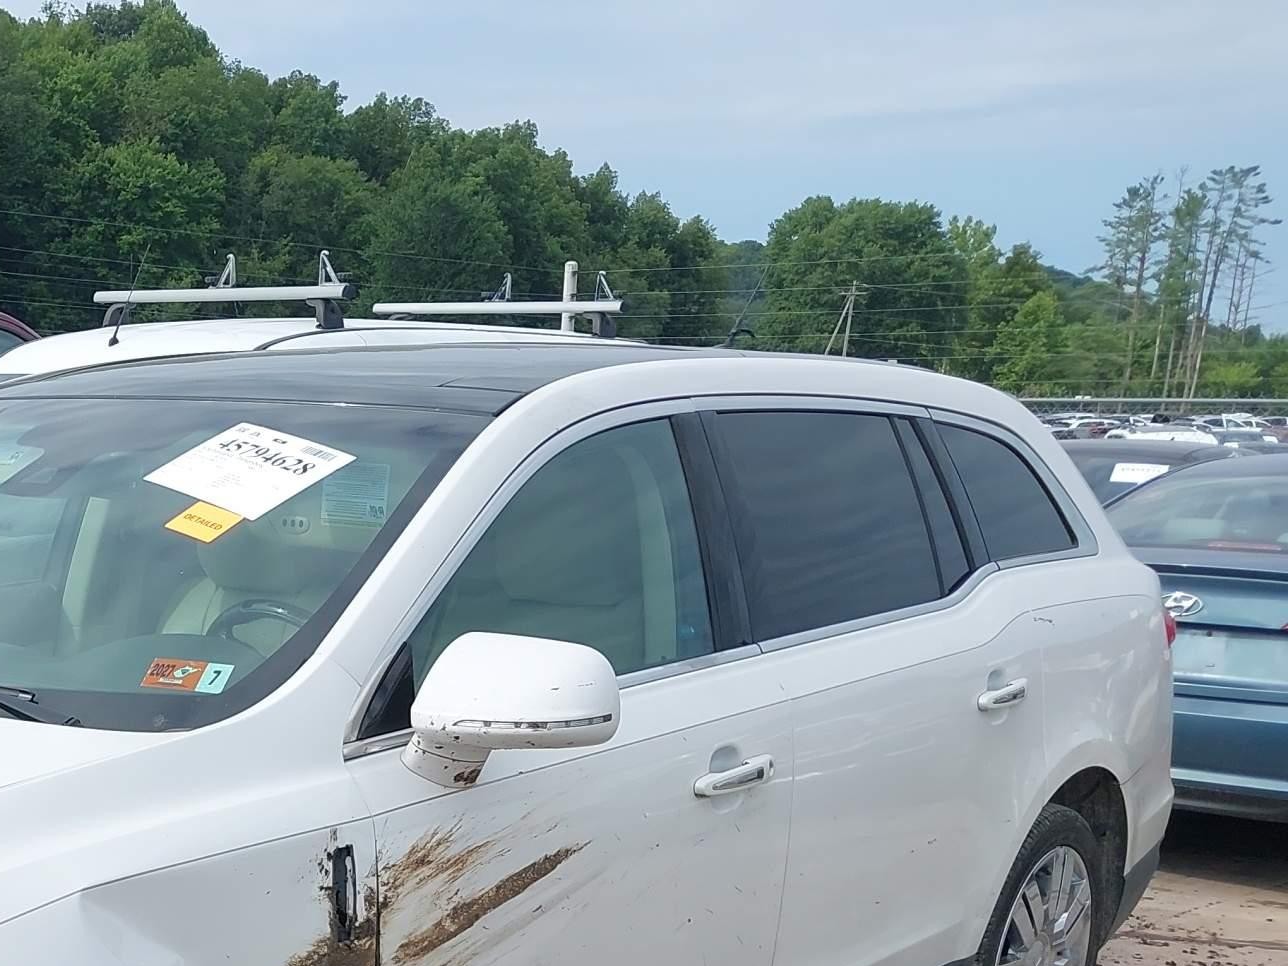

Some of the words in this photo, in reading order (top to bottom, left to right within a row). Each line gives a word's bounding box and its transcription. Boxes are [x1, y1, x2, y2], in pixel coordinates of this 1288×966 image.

[218, 438, 316, 476] 45794628
[183, 513, 223, 531] DETAILED
[149, 663, 177, 678] 2027
[208, 670, 222, 686] 7
